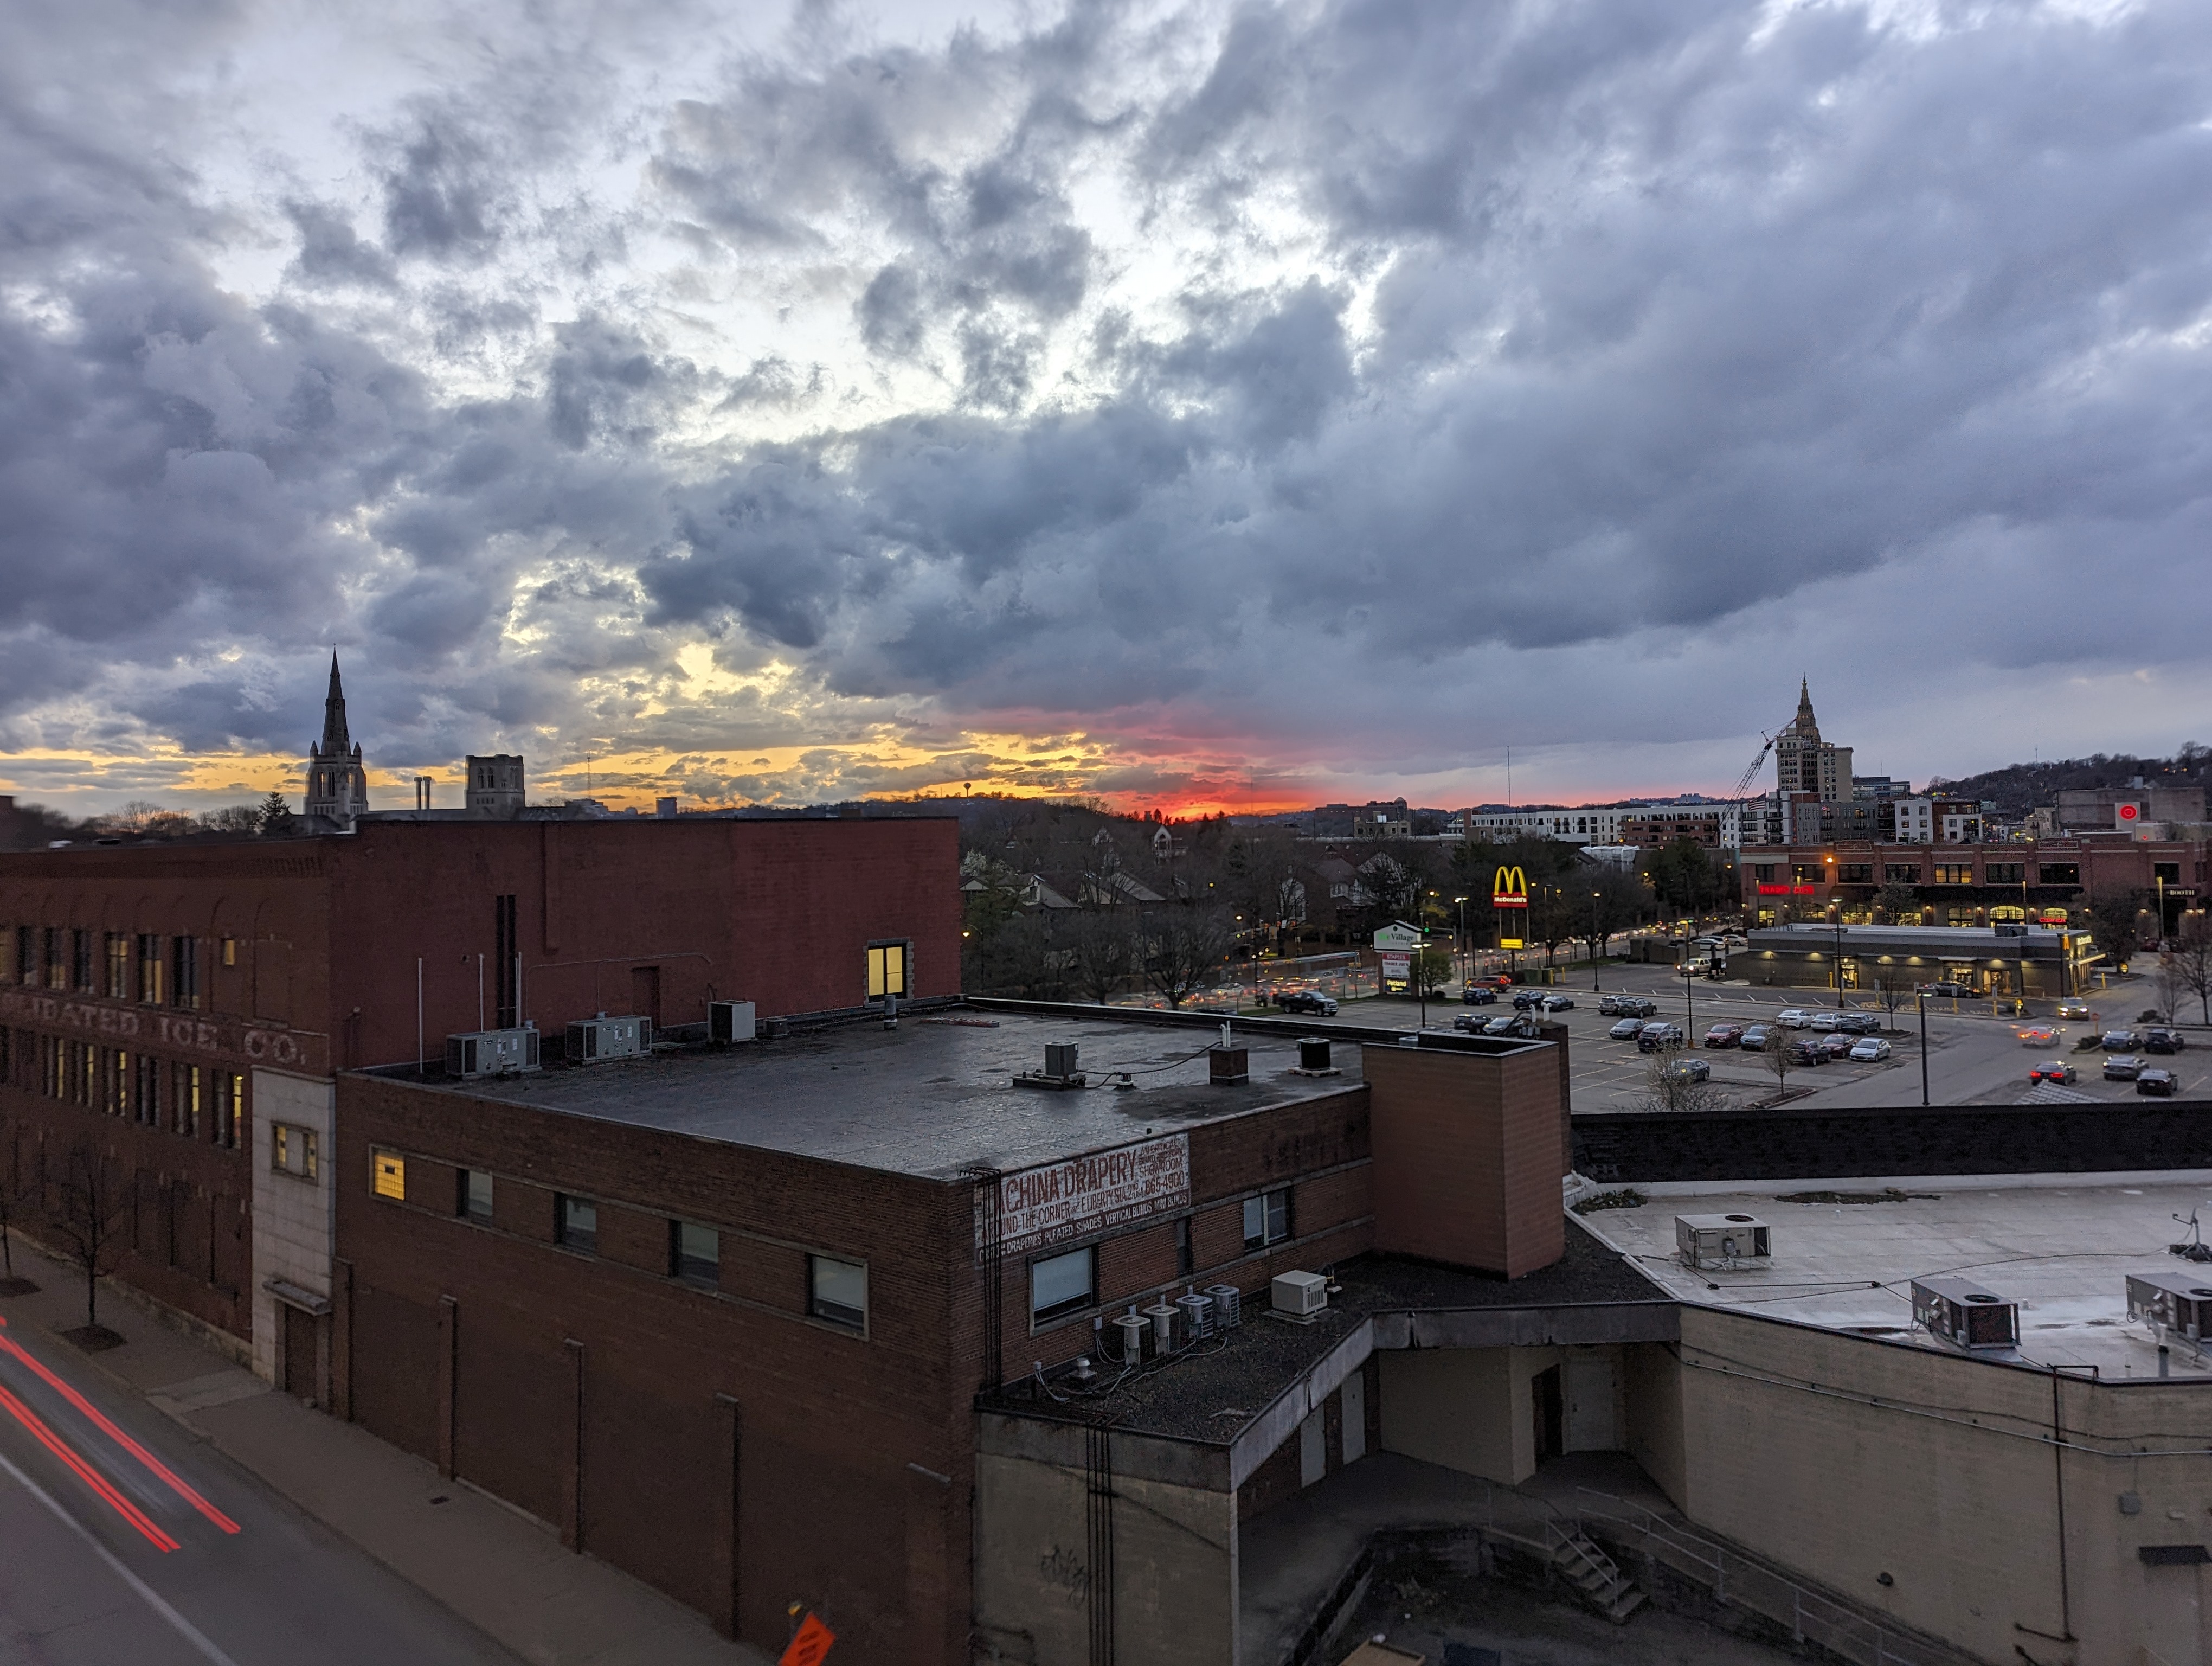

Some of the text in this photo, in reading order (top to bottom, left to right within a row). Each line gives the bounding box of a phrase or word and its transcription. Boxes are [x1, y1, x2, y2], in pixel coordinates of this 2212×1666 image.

[1759, 886, 1790, 894] TRADE
[1391, 933, 1414, 942] Village
[159, 1016, 217, 1049] ICE
[243, 1030, 306, 1065] CO.
[1064, 1149, 1136, 1197] DRAPERY
[1139, 1157, 1182, 1178] SHOWROOM
[1007, 1234, 1041, 1252] DRAPERIES
[1045, 1225, 1073, 1243] PLEATED
[1077, 1216, 1102, 1234] SHADES
[1105, 1208, 1131, 1225] VERTICAL
[1133, 1202, 1152, 1218] BLINDS
[1167, 1193, 1187, 1208] BLINDS
[1021, 1210, 1036, 1230] THE
[1039, 1201, 1070, 1225] CORNER
[1145, 1171, 1184, 1195] 665-4900
